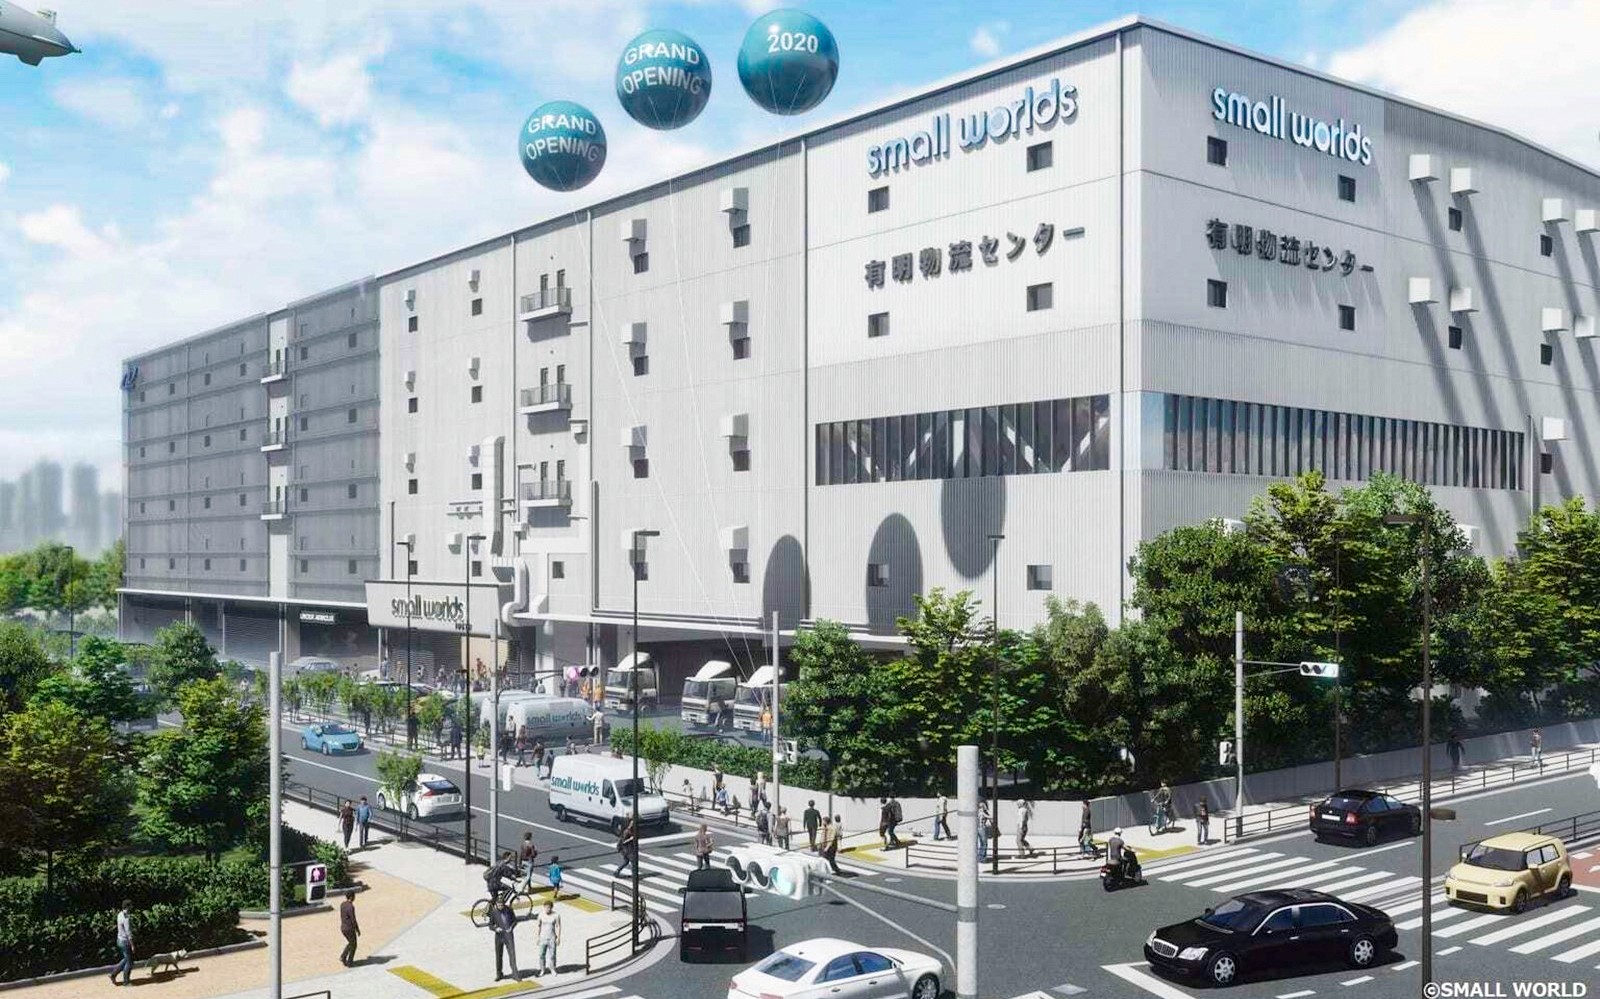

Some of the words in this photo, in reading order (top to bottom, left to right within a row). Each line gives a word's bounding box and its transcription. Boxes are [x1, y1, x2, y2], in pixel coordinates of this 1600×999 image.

[624, 42, 700, 65] GRAND
[767, 32, 819, 54] 2020
[622, 66, 704, 95] OPENING
[527, 113, 597, 136] GRAND
[867, 113, 950, 176] small
[959, 78, 1078, 149] worlds
[1212, 87, 1285, 139] small
[1290, 112, 1372, 166] worlds
[525, 136, 600, 162] OPENING
[865, 222, 1086, 290] 有明物流センター
[1206, 218, 1374, 276] 有明物流センター
[391, 594, 421, 618] small
[423, 596, 464, 621] worlds
[527, 713, 551, 725] small
[551, 776, 573, 789] small
[573, 780, 599, 796] worlds
